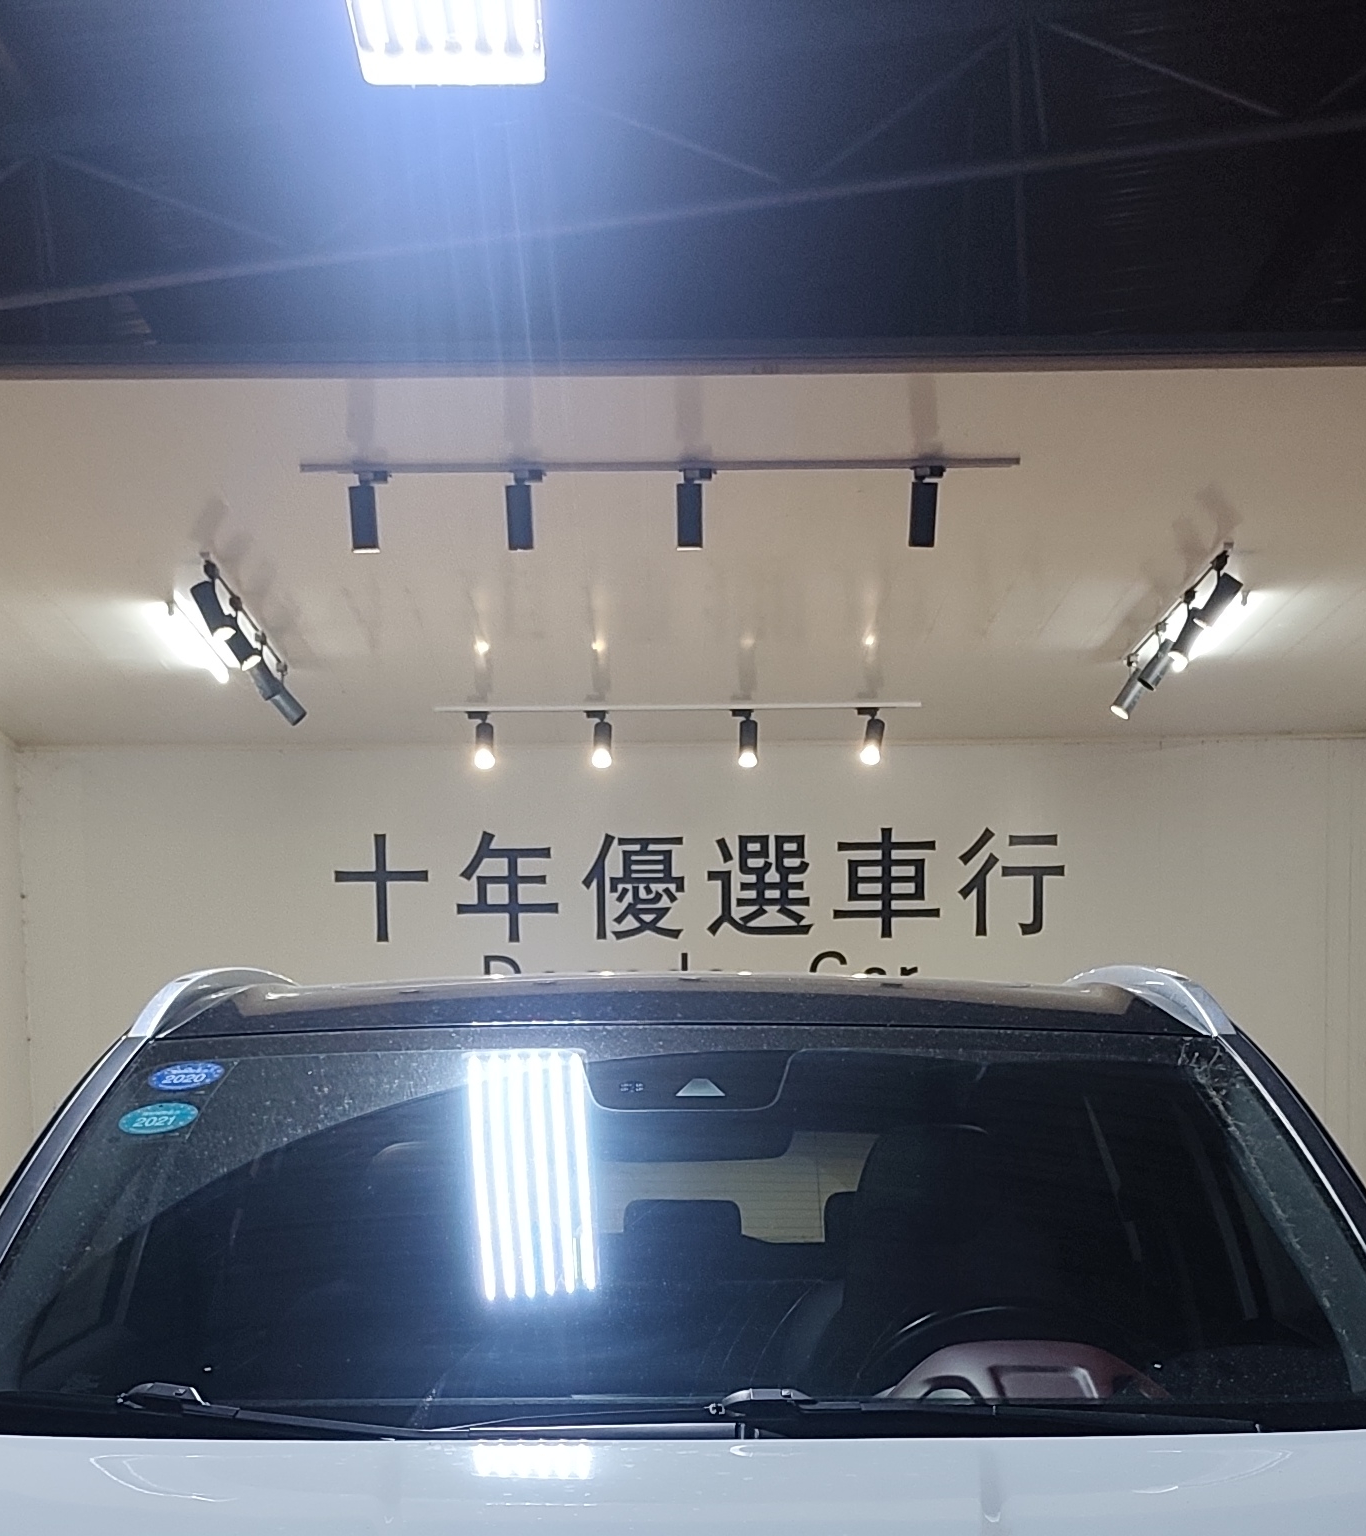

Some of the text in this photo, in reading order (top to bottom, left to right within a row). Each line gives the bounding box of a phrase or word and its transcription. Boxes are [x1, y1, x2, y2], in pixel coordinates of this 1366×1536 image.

[333, 827, 1066, 942] 十年優選車行
[161, 1073, 207, 1084] 2020
[132, 1115, 176, 1127] 2021
